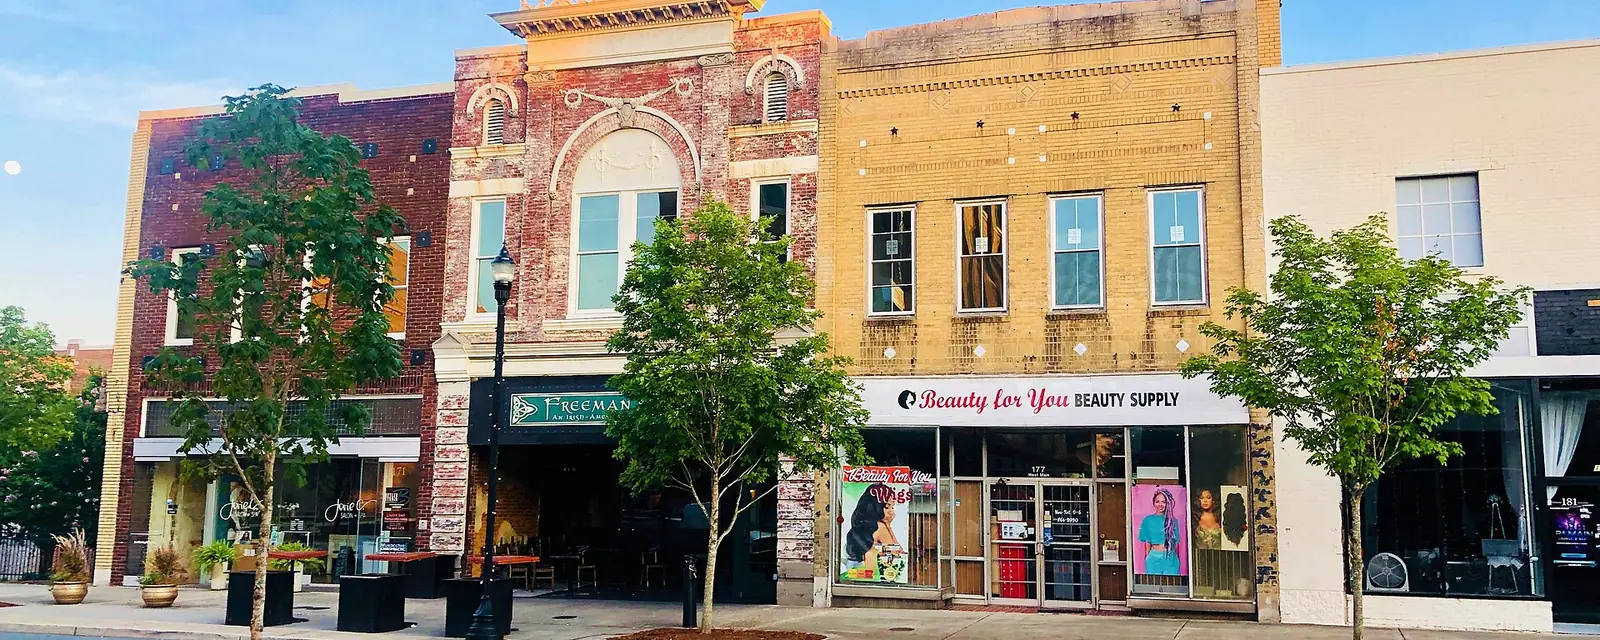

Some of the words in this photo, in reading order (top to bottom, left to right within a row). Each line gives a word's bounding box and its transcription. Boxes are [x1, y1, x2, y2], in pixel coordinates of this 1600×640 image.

[919, 389, 988, 414] Beauty
[993, 388, 1023, 410] for
[1027, 388, 1070, 414] You
[1074, 393, 1125, 408] BEAUTY
[1130, 392, 1180, 407] SUPPLY
[844, 467, 891, 486] Beauty
[908, 470, 933, 487] You
[1031, 465, 1046, 473] 177
[870, 484, 913, 504] Wigs
[1561, 497, 1578, 506] 181
